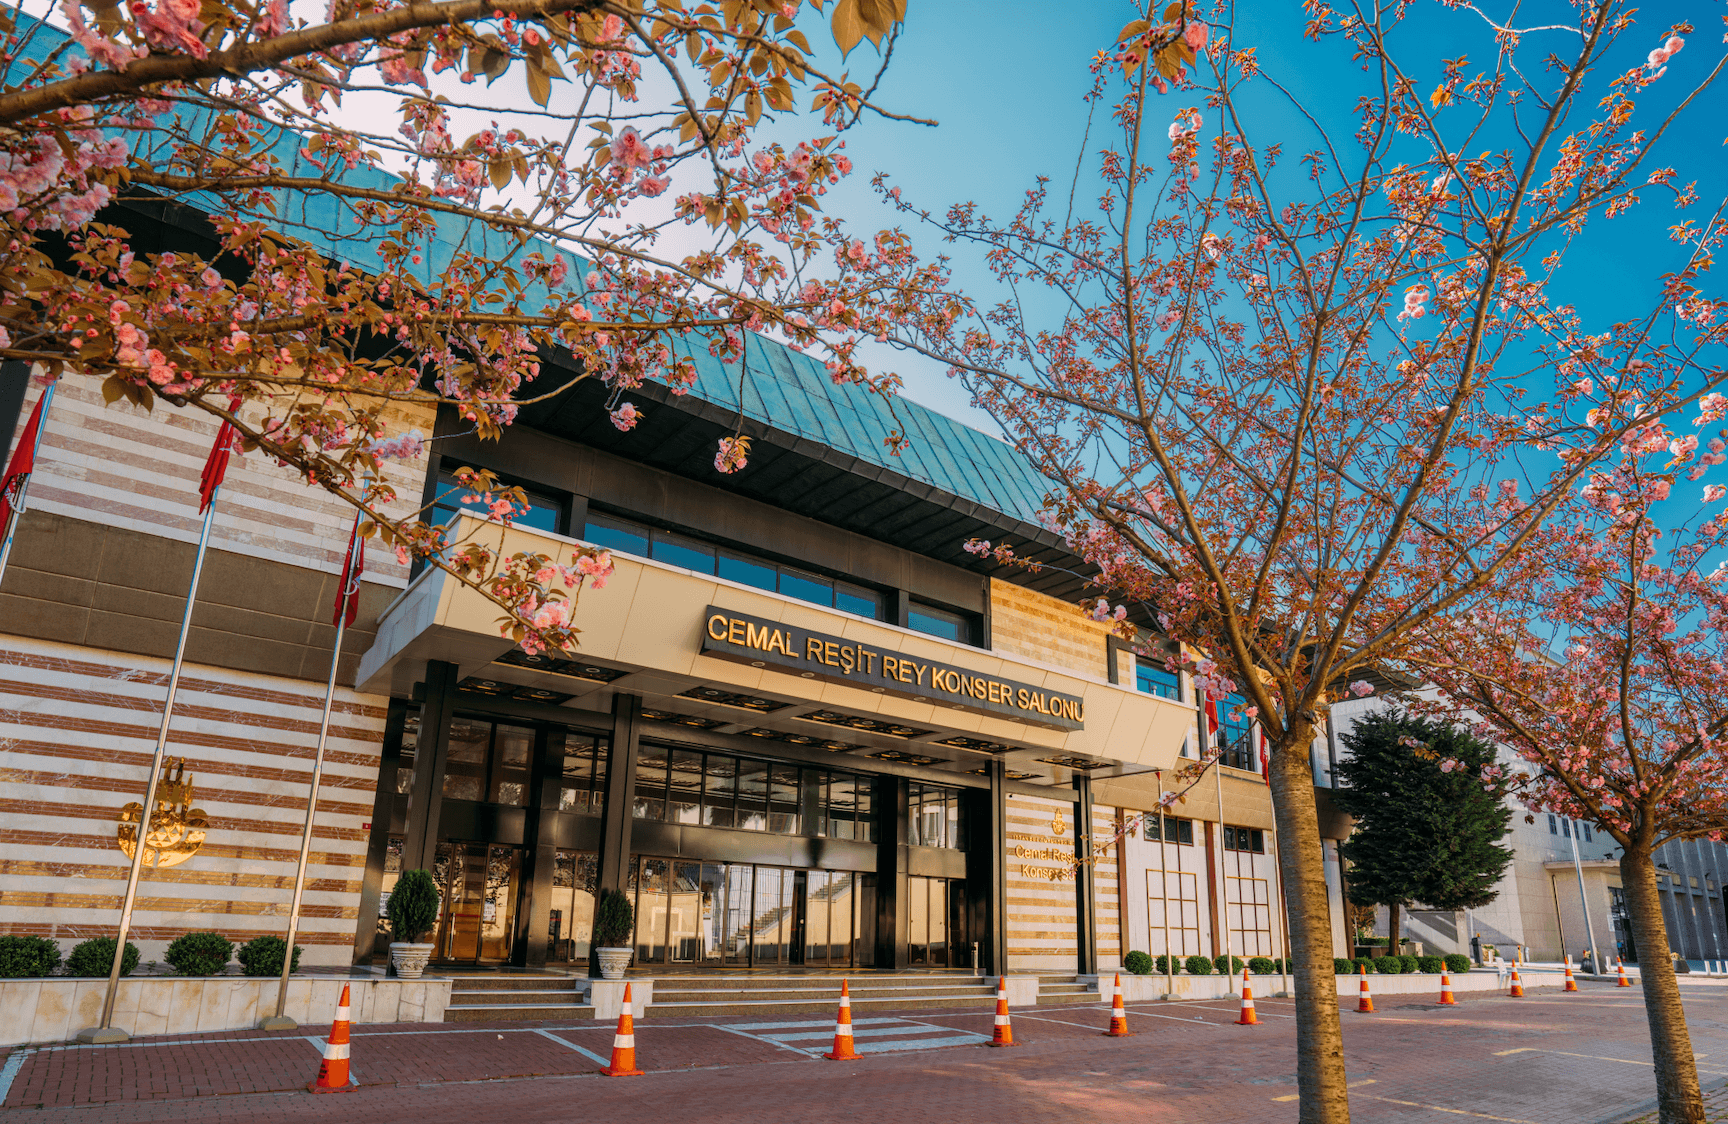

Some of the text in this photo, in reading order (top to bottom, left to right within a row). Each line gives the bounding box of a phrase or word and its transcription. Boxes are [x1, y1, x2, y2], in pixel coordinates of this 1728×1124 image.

[707, 614, 1085, 723] CEMAL REŞİT REY KONSER SALONU
[1015, 844, 1049, 861] Cemal
[1052, 847, 1076, 866] Reşi
